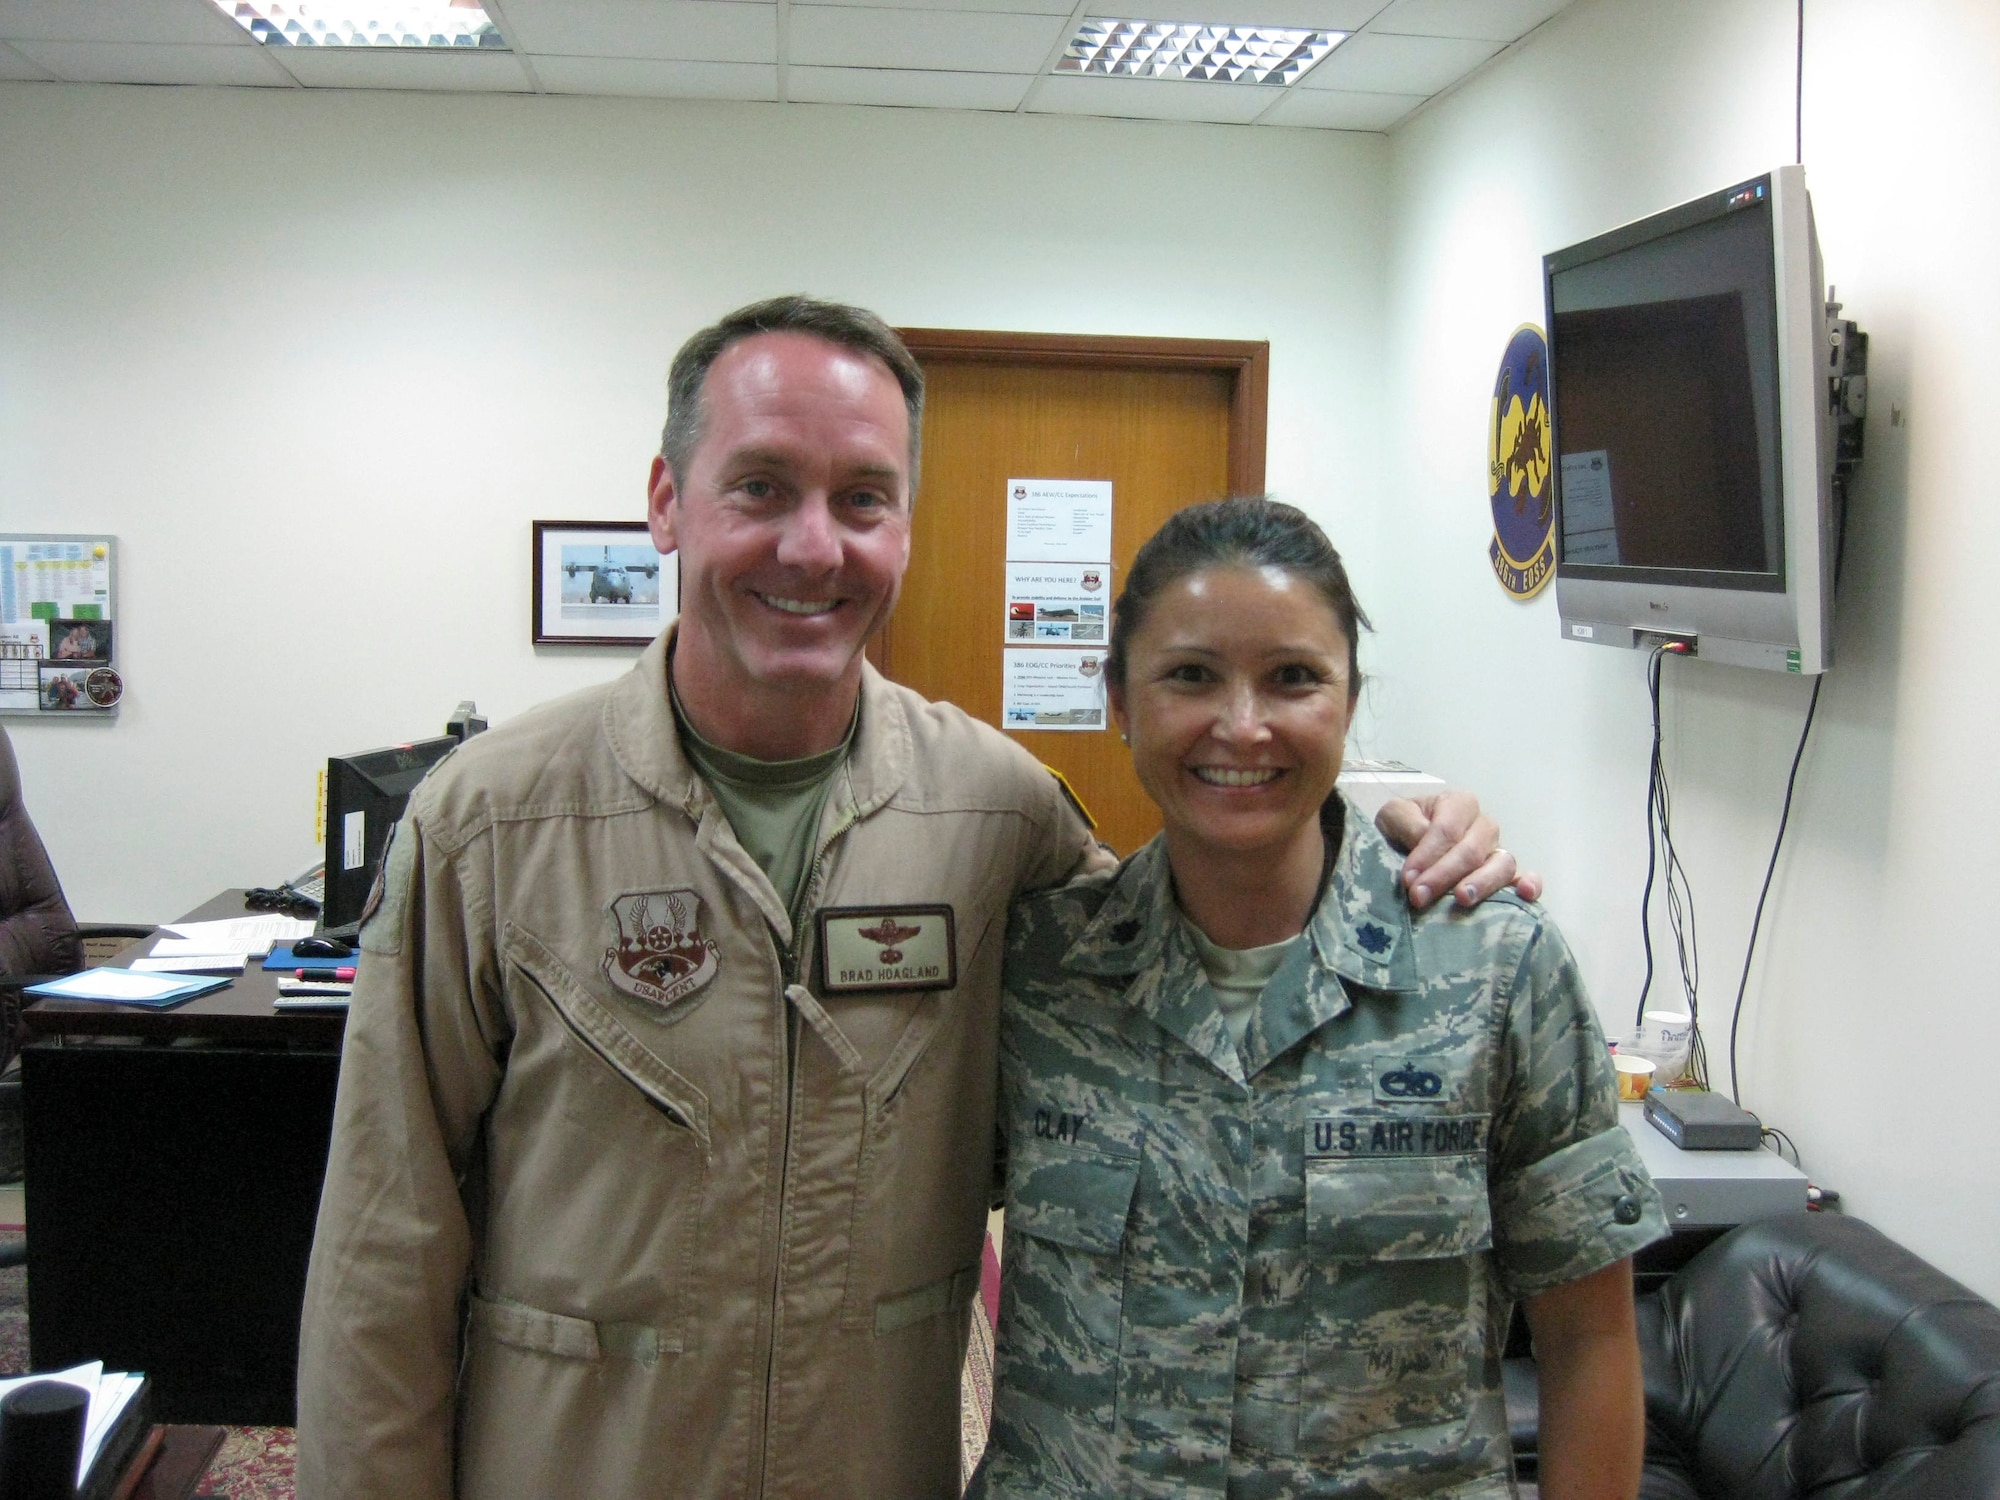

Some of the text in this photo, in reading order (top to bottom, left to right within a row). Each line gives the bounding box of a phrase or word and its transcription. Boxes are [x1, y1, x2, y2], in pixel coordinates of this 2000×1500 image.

[1495, 550, 1546, 590] 386TH EOSS
[840, 965, 939, 982] BRAD HOAGLAND
[1035, 1107, 1084, 1143] CLAY
[1371, 1121, 1414, 1151] AIR
[1421, 1119, 1482, 1151] FORCE
